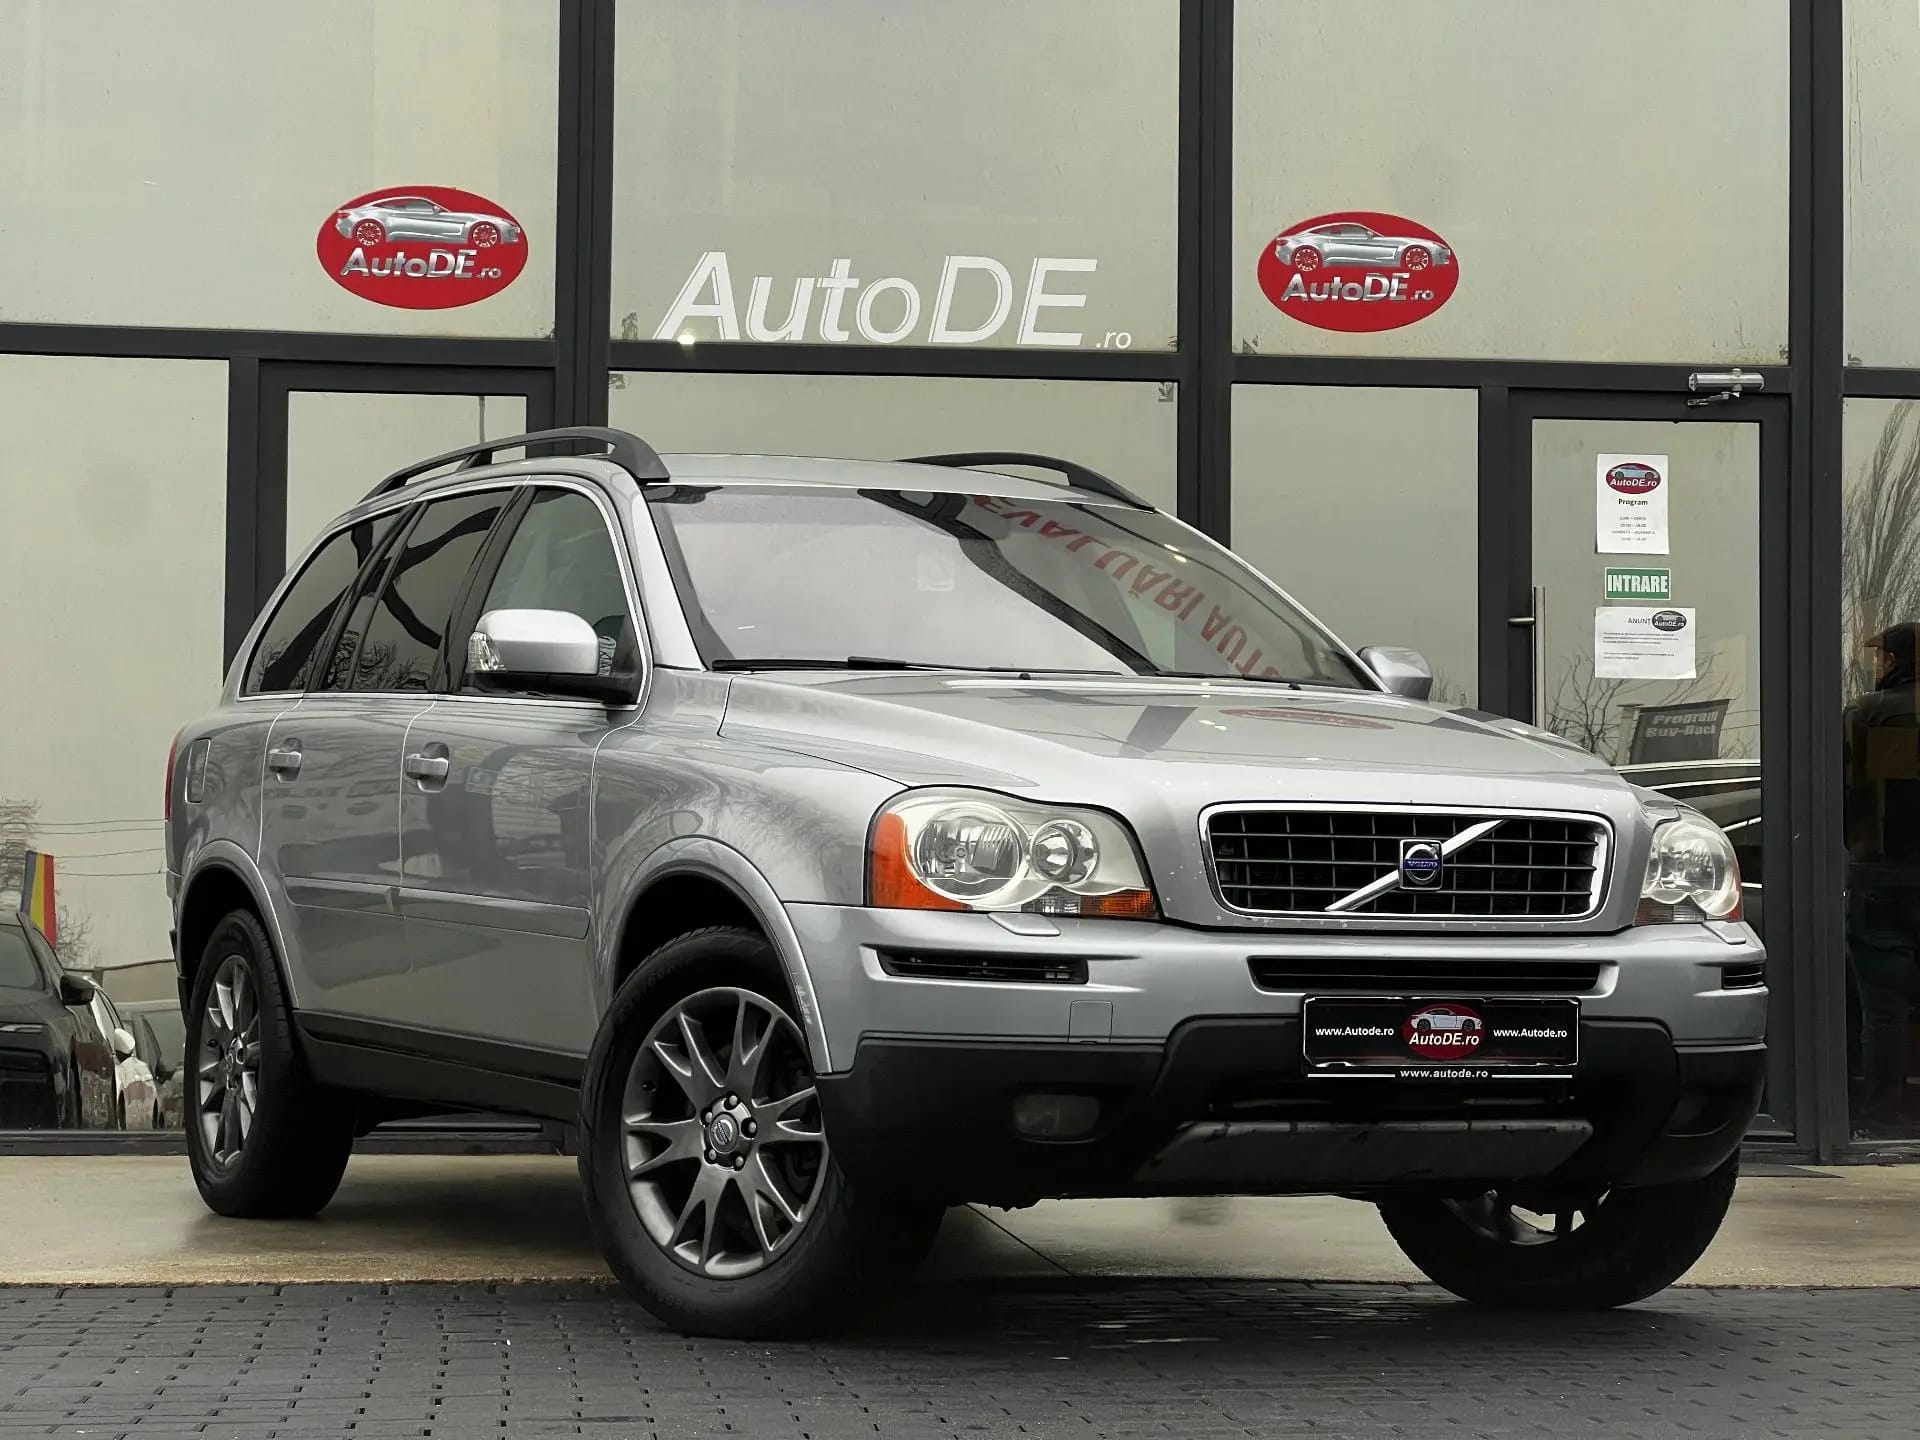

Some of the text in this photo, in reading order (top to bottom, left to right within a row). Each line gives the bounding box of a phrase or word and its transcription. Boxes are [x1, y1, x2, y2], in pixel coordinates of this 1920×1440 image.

[340, 247, 501, 279] AutoDE.ro
[1281, 272, 1434, 302] AutoDE.ro
[652, 251, 1132, 347] AutoDE.ro
[1610, 478, 1657, 487] AutoDE.ro
[1618, 498, 1649, 507] Program
[1607, 574, 1668, 593] INTRARE
[1315, 1026, 1395, 1036] www.Autode.ro
[1493, 1027, 1568, 1038] www.Autode.ro
[1409, 1031, 1480, 1046] AutoDE.ro
[1400, 1068, 1488, 1078] www.autode.ro
